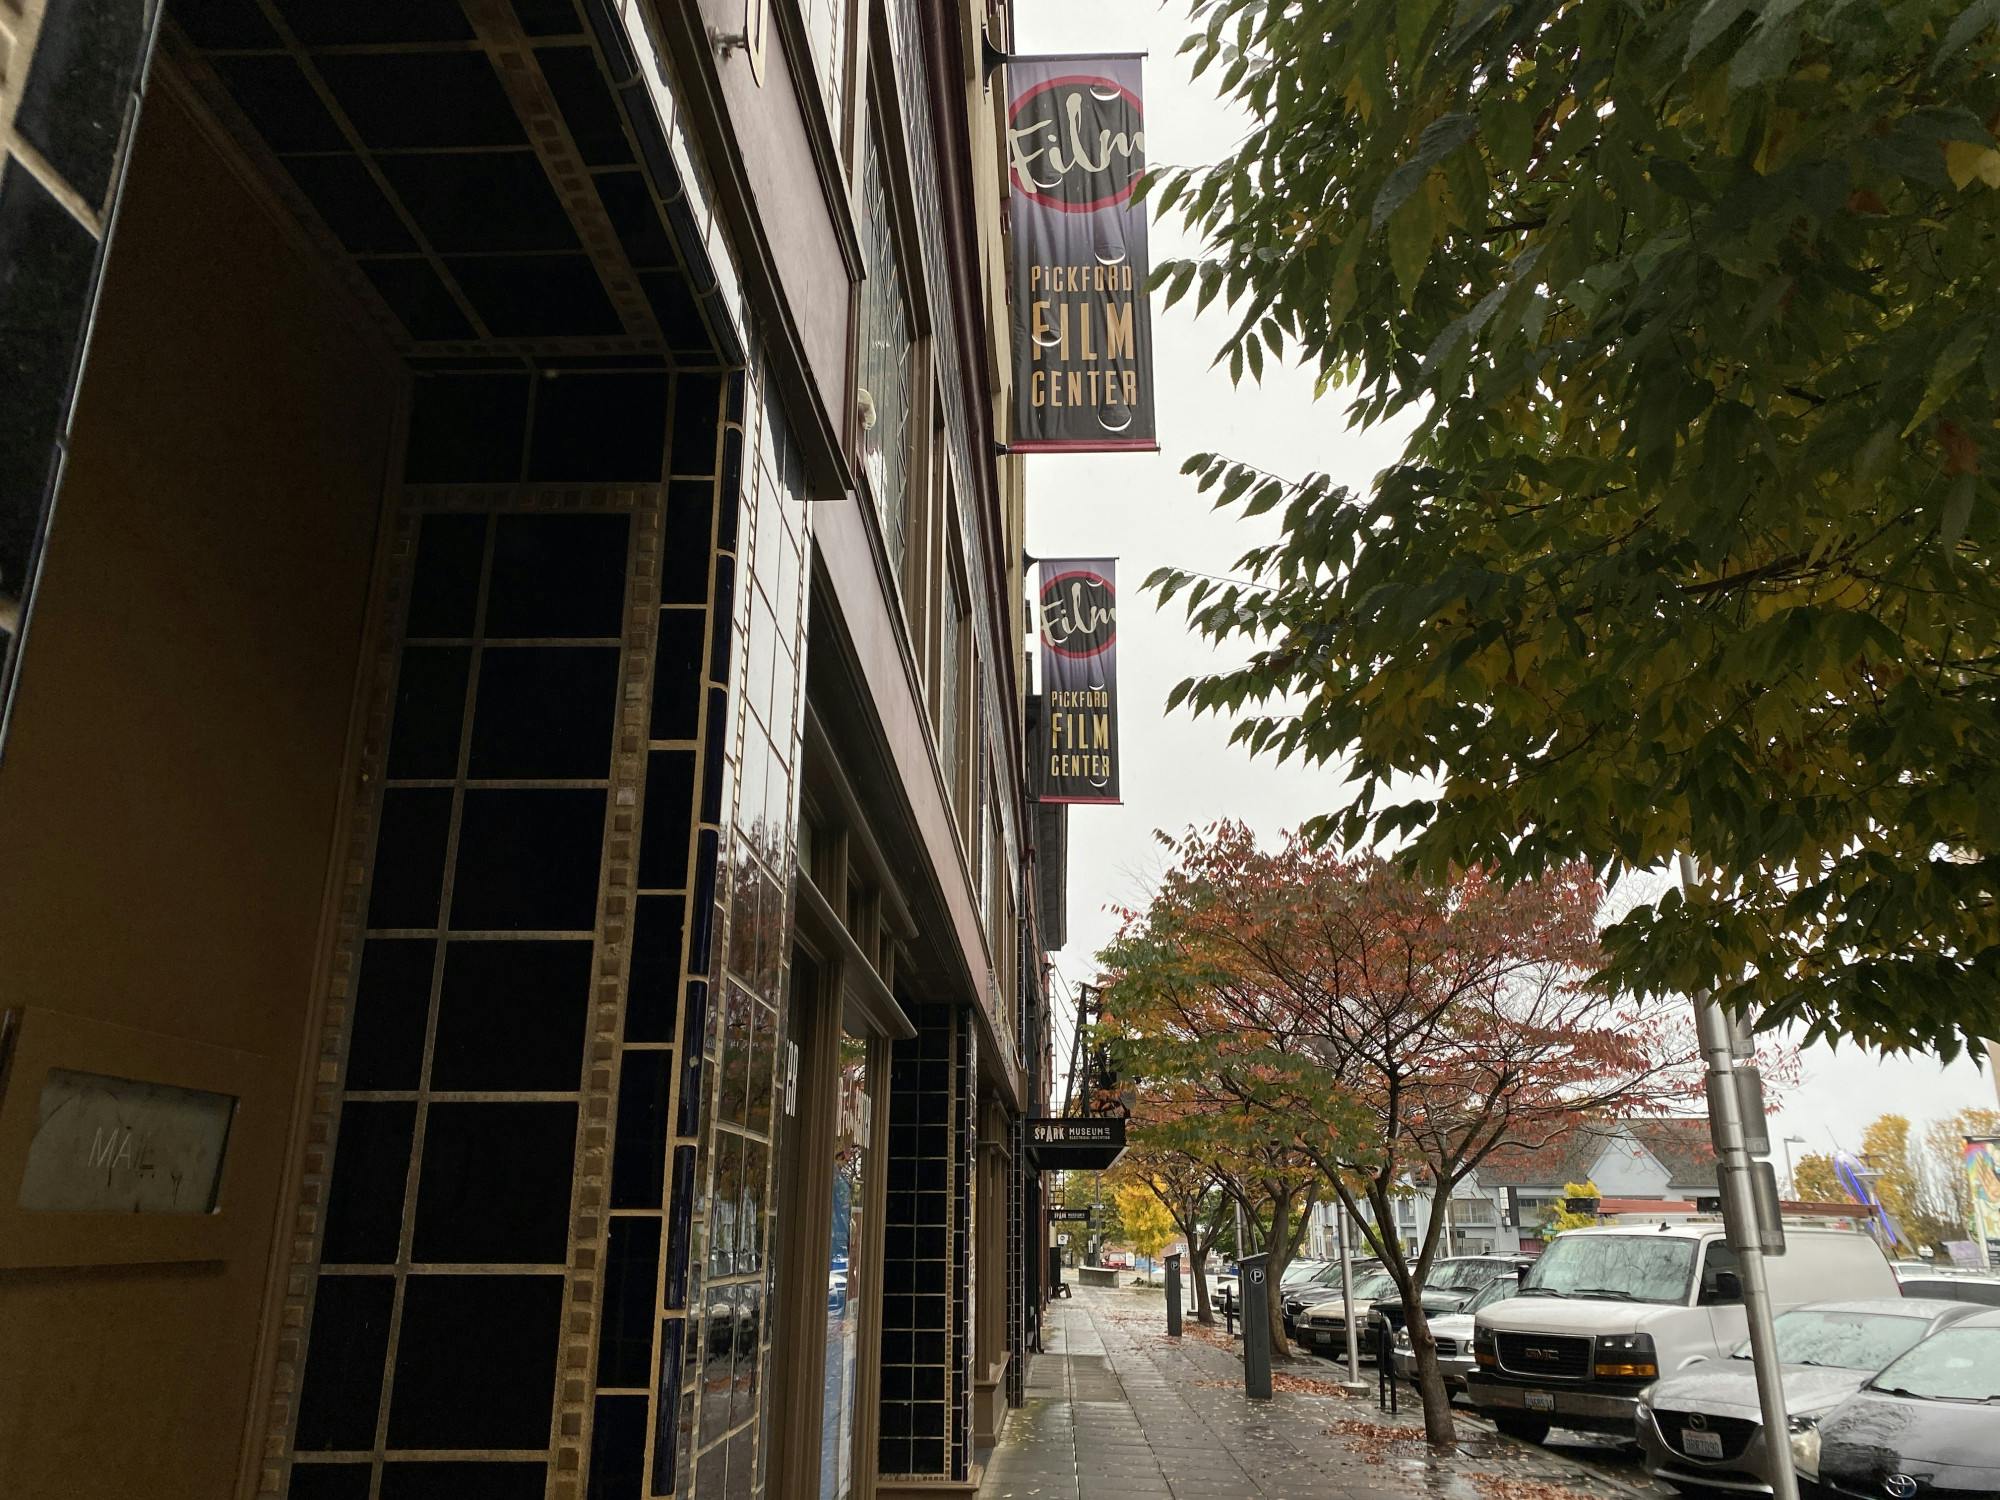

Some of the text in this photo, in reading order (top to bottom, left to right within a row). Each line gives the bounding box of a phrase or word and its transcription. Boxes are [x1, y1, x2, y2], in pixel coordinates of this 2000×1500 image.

[1009, 92, 1144, 194] Film
[1032, 300, 1135, 362] FILM
[1031, 369, 1137, 408] CENTER
[1040, 582, 1116, 647] Film
[1052, 712, 1109, 750] FILM
[1051, 754, 1110, 777] CENTER
[1034, 1126, 1065, 1142] SPARK
[1069, 1127, 1104, 1136] MUSEUM
[1525, 1347, 1560, 1361] GMC
